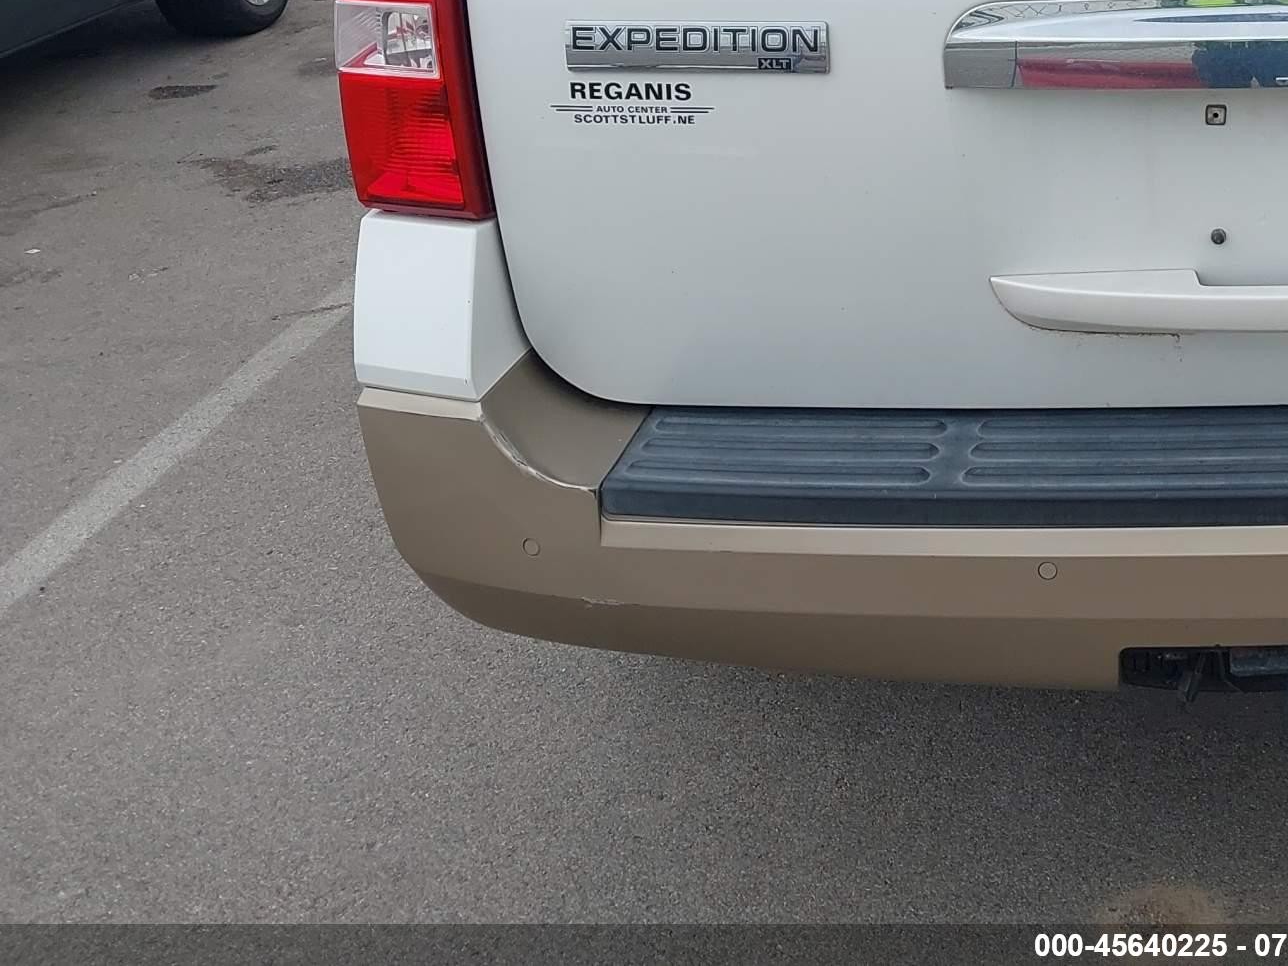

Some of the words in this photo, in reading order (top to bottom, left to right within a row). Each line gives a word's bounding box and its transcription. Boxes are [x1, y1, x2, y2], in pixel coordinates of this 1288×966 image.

[571, 25, 820, 53] EXPEDITION
[760, 58, 790, 69] XLT
[569, 82, 692, 100] REGANIS
[596, 105, 625, 113] AUTO
[627, 106, 668, 114] CENTER
